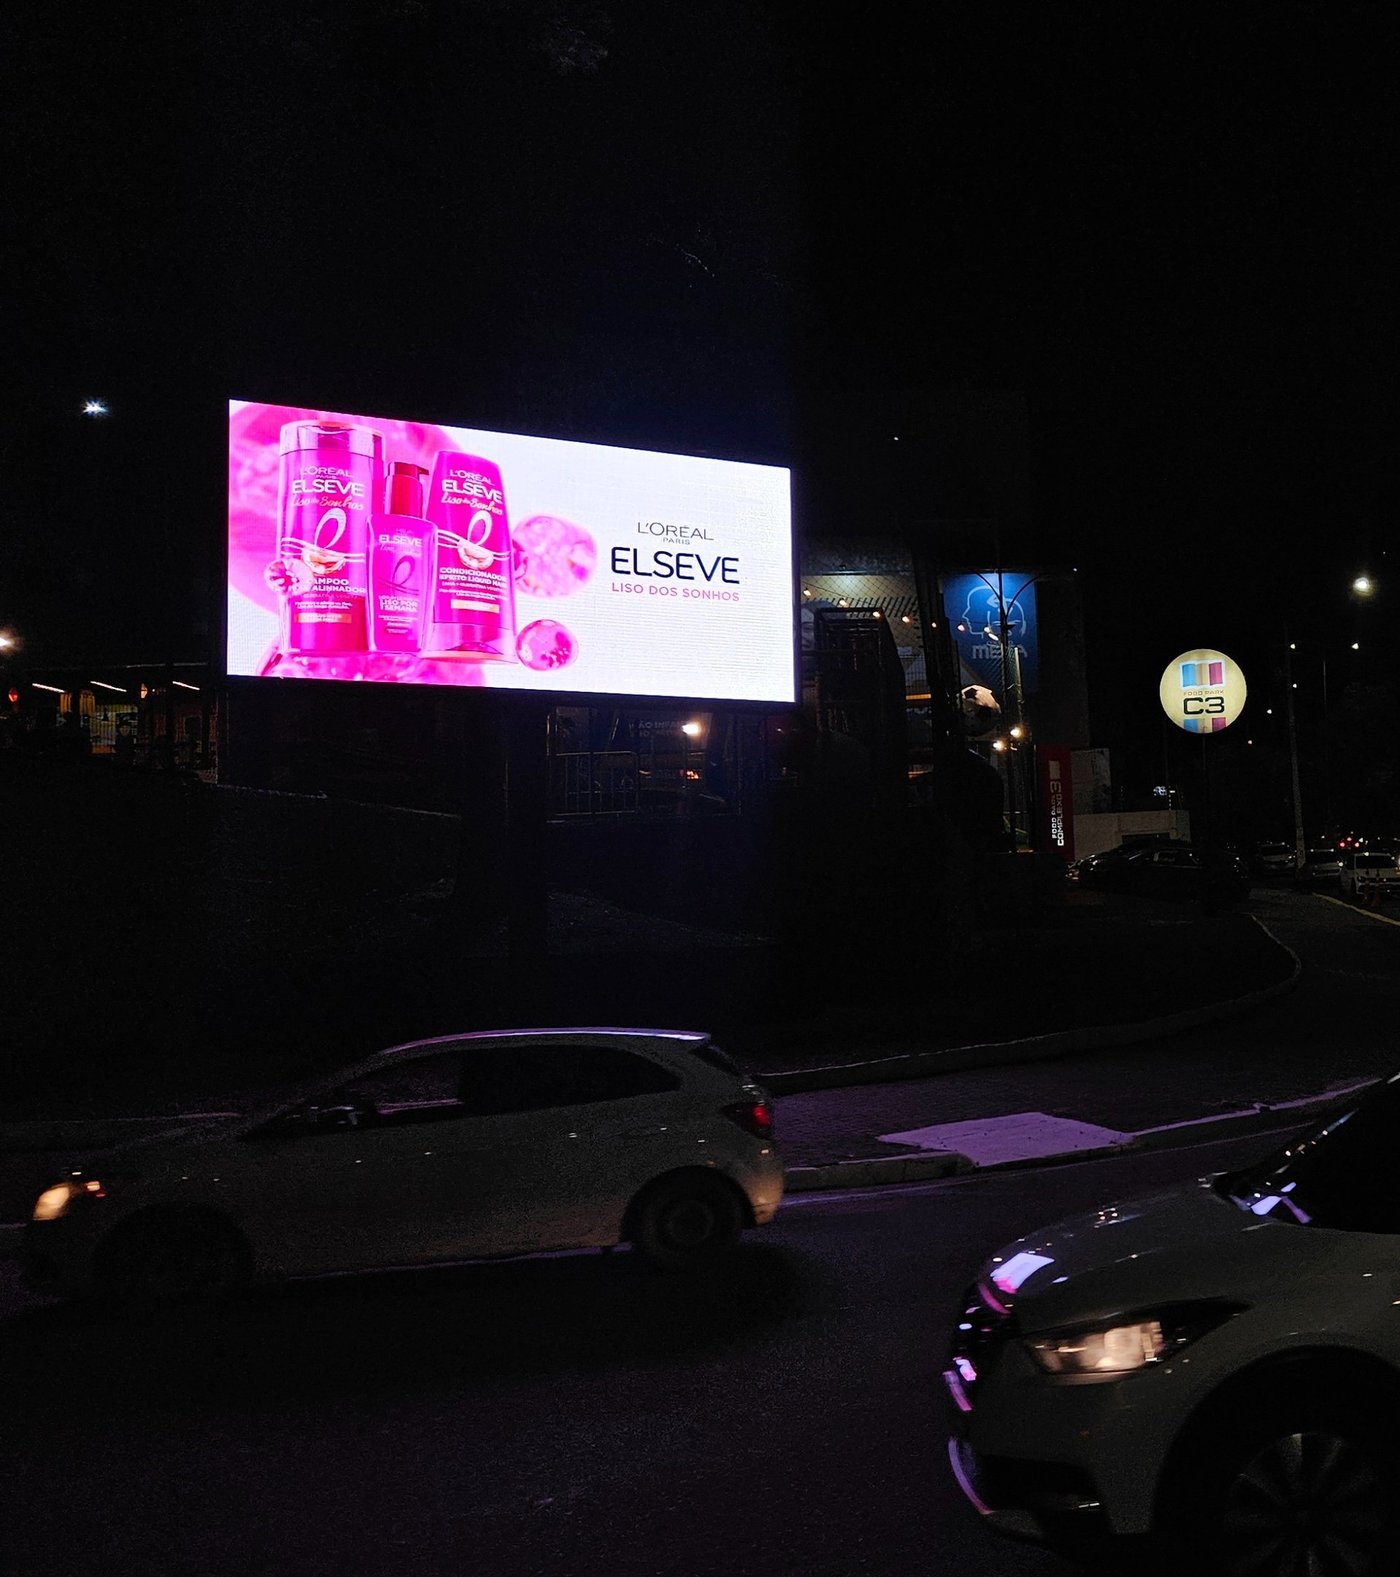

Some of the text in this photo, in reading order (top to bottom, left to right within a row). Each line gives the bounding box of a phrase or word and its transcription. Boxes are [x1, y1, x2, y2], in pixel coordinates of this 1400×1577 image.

[292, 479, 365, 497] ELSEVE
[441, 479, 503, 505] ELSEVE
[379, 534, 422, 548] ELSEVE
[662, 537, 691, 546] PARIS
[610, 546, 740, 585] ELSEVE
[611, 582, 740, 602] LISO DOS SONHOS
[1183, 696, 1225, 715] C3
[1056, 793, 1064, 846] COMPLEXO
